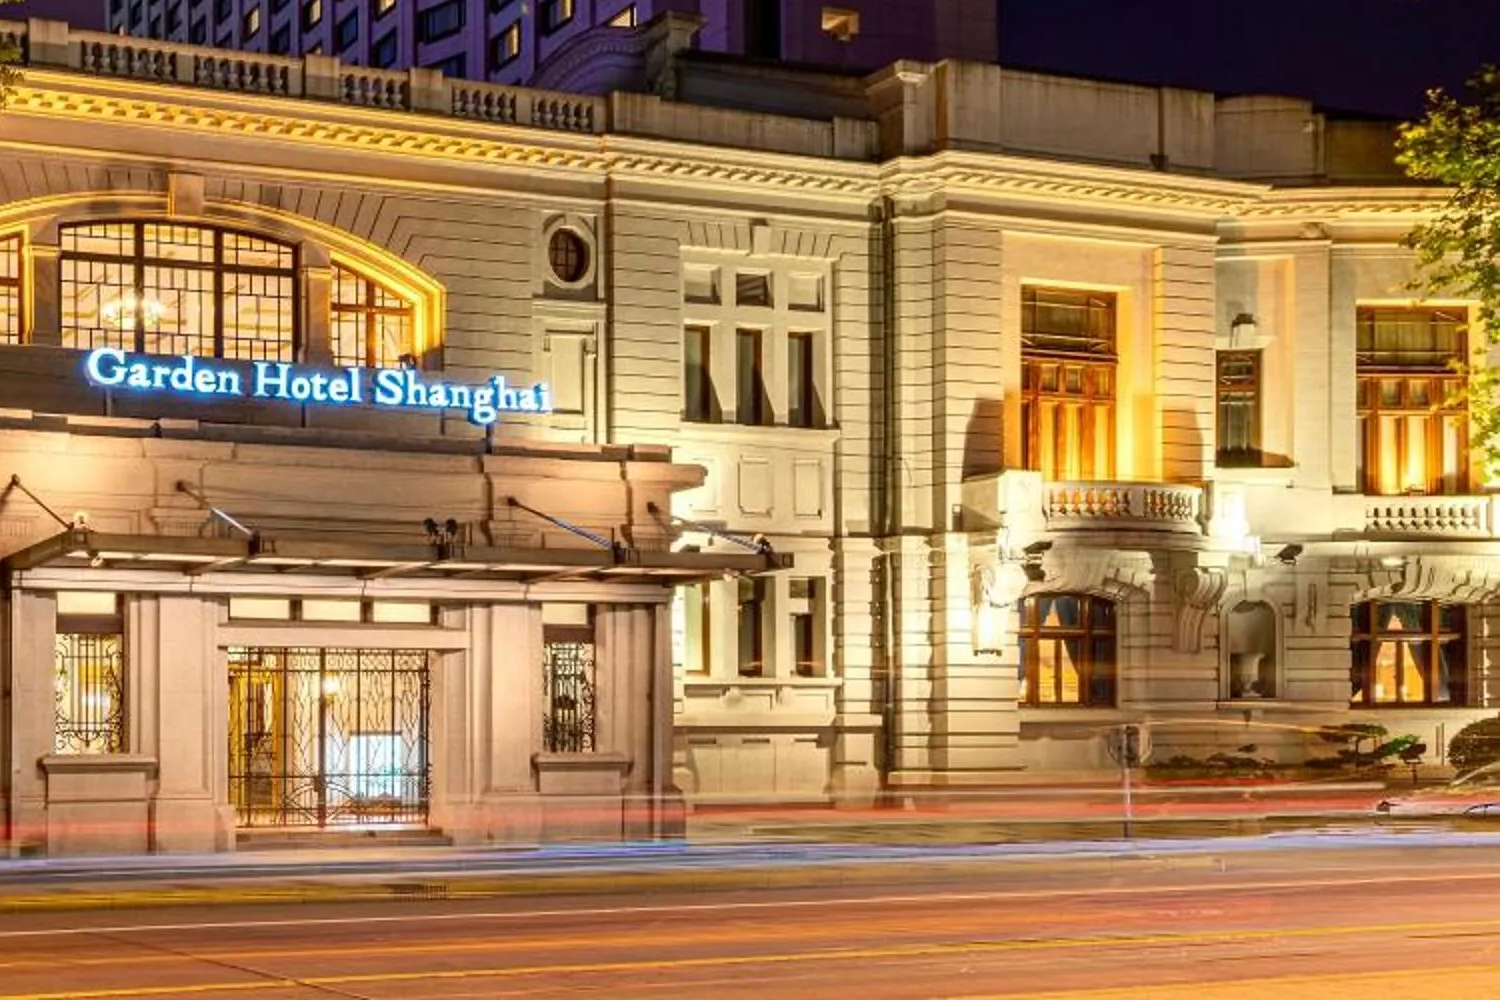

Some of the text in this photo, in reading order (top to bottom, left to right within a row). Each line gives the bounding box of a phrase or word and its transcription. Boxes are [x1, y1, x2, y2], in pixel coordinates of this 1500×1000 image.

[87, 347, 552, 424] Garden Hotel Shanghai
